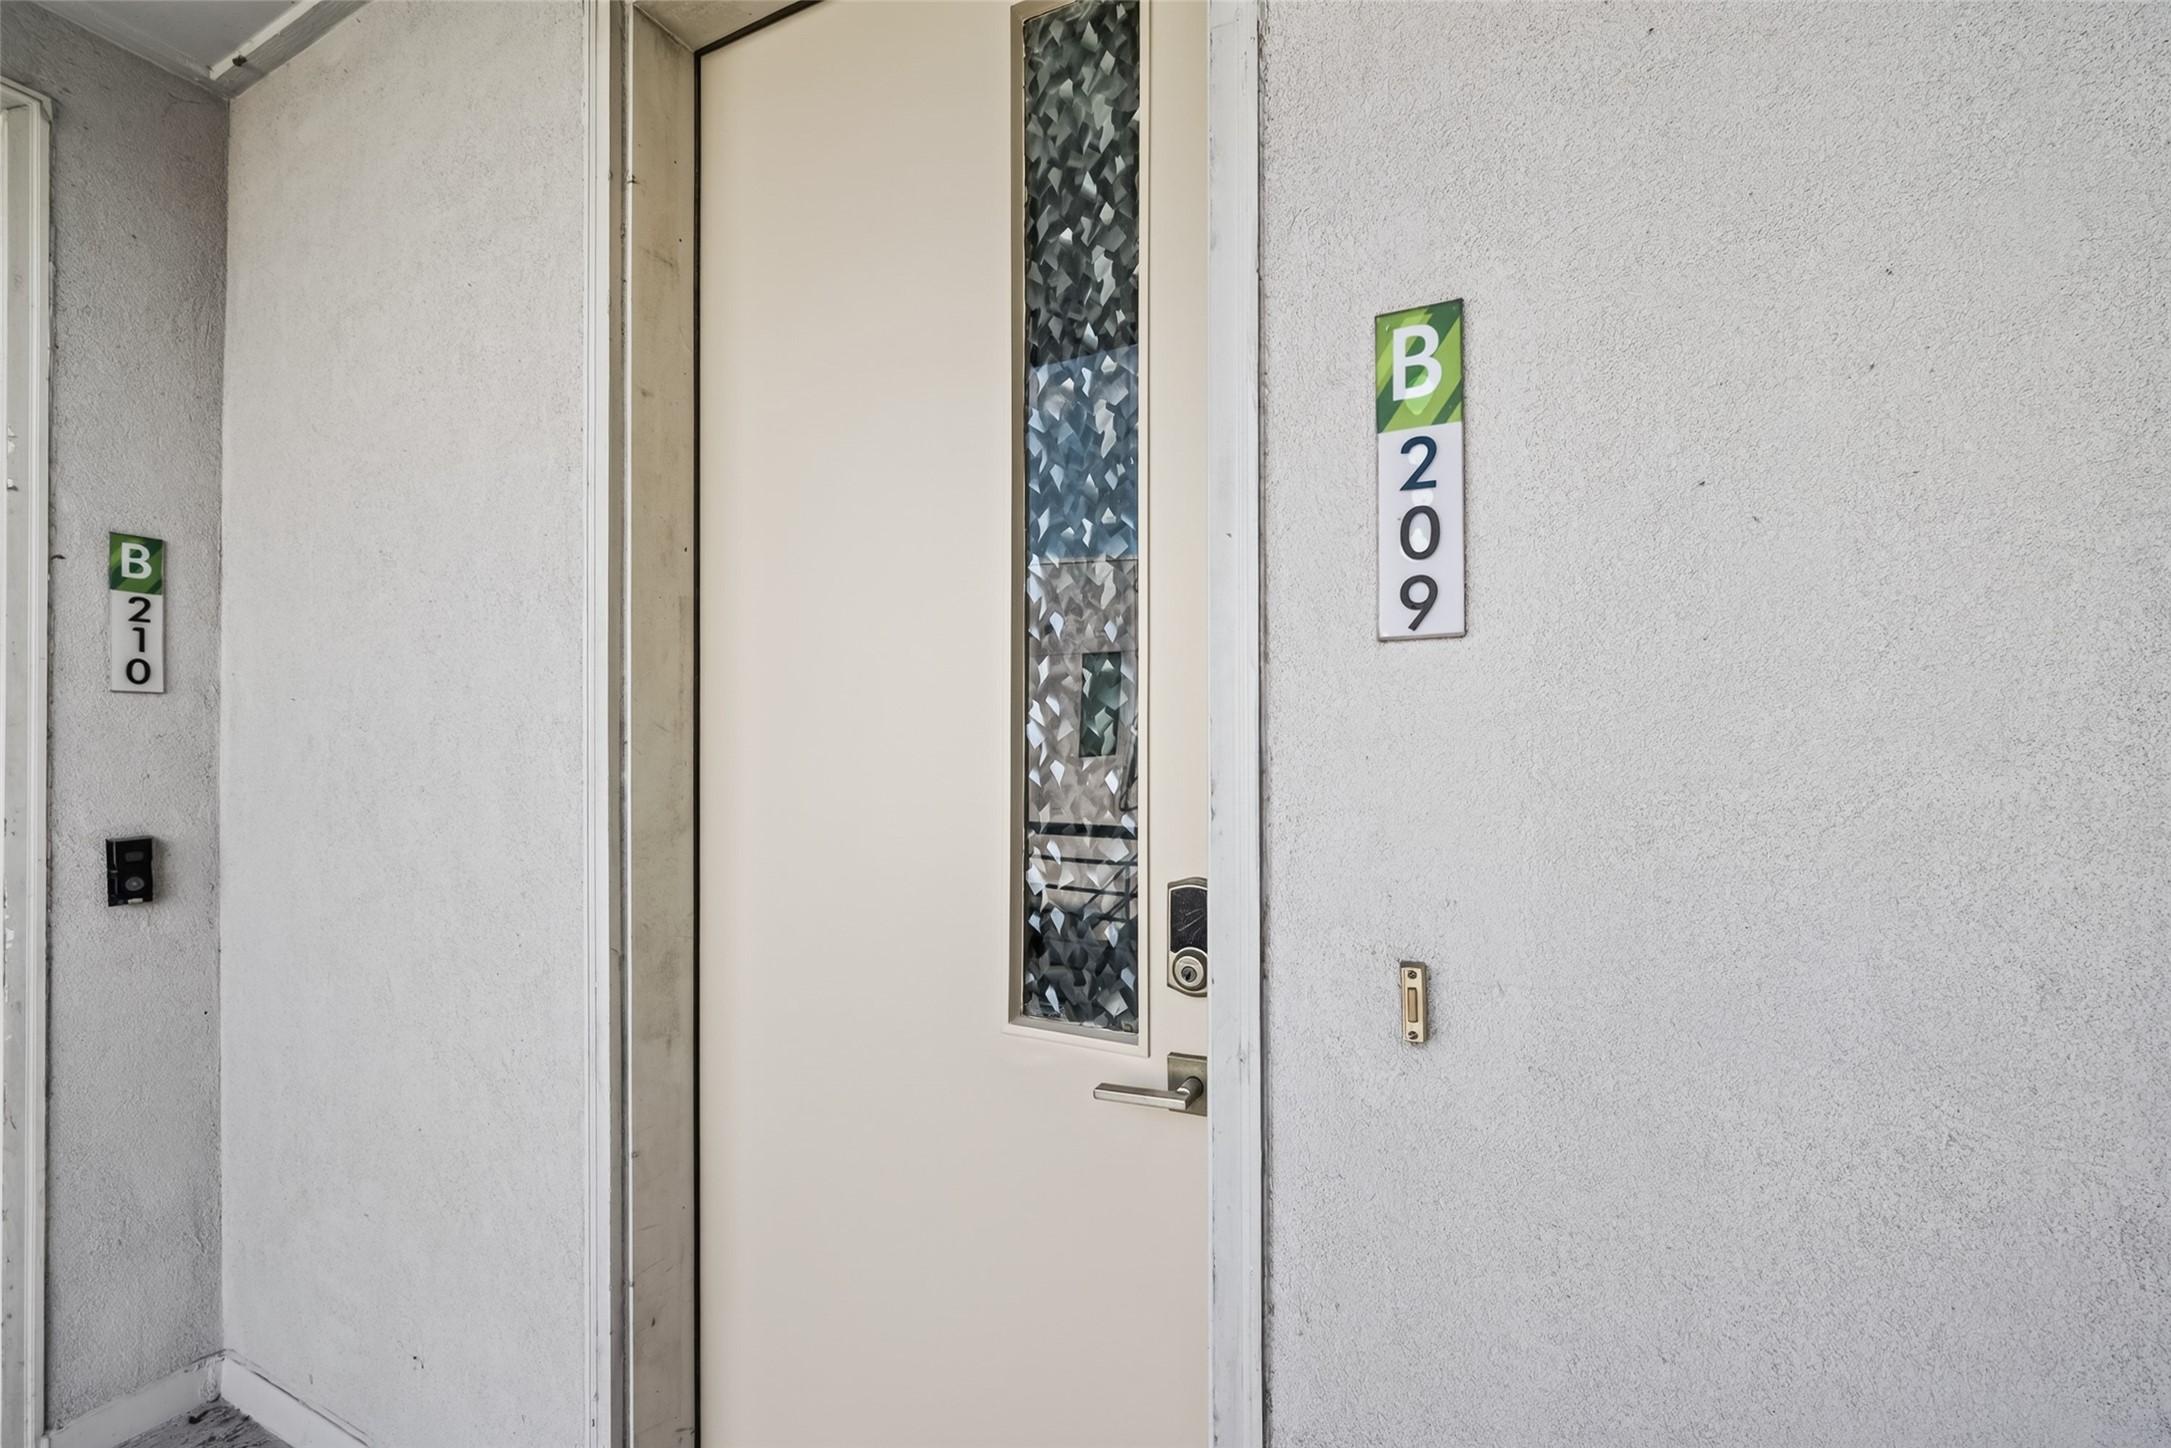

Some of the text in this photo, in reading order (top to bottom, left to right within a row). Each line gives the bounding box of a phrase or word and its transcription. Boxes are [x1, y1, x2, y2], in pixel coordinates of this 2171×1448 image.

[1393, 324, 1442, 401] B
[121, 542, 152, 579] B
[1399, 436, 1441, 631] 209
[126, 596, 151, 685] 210
